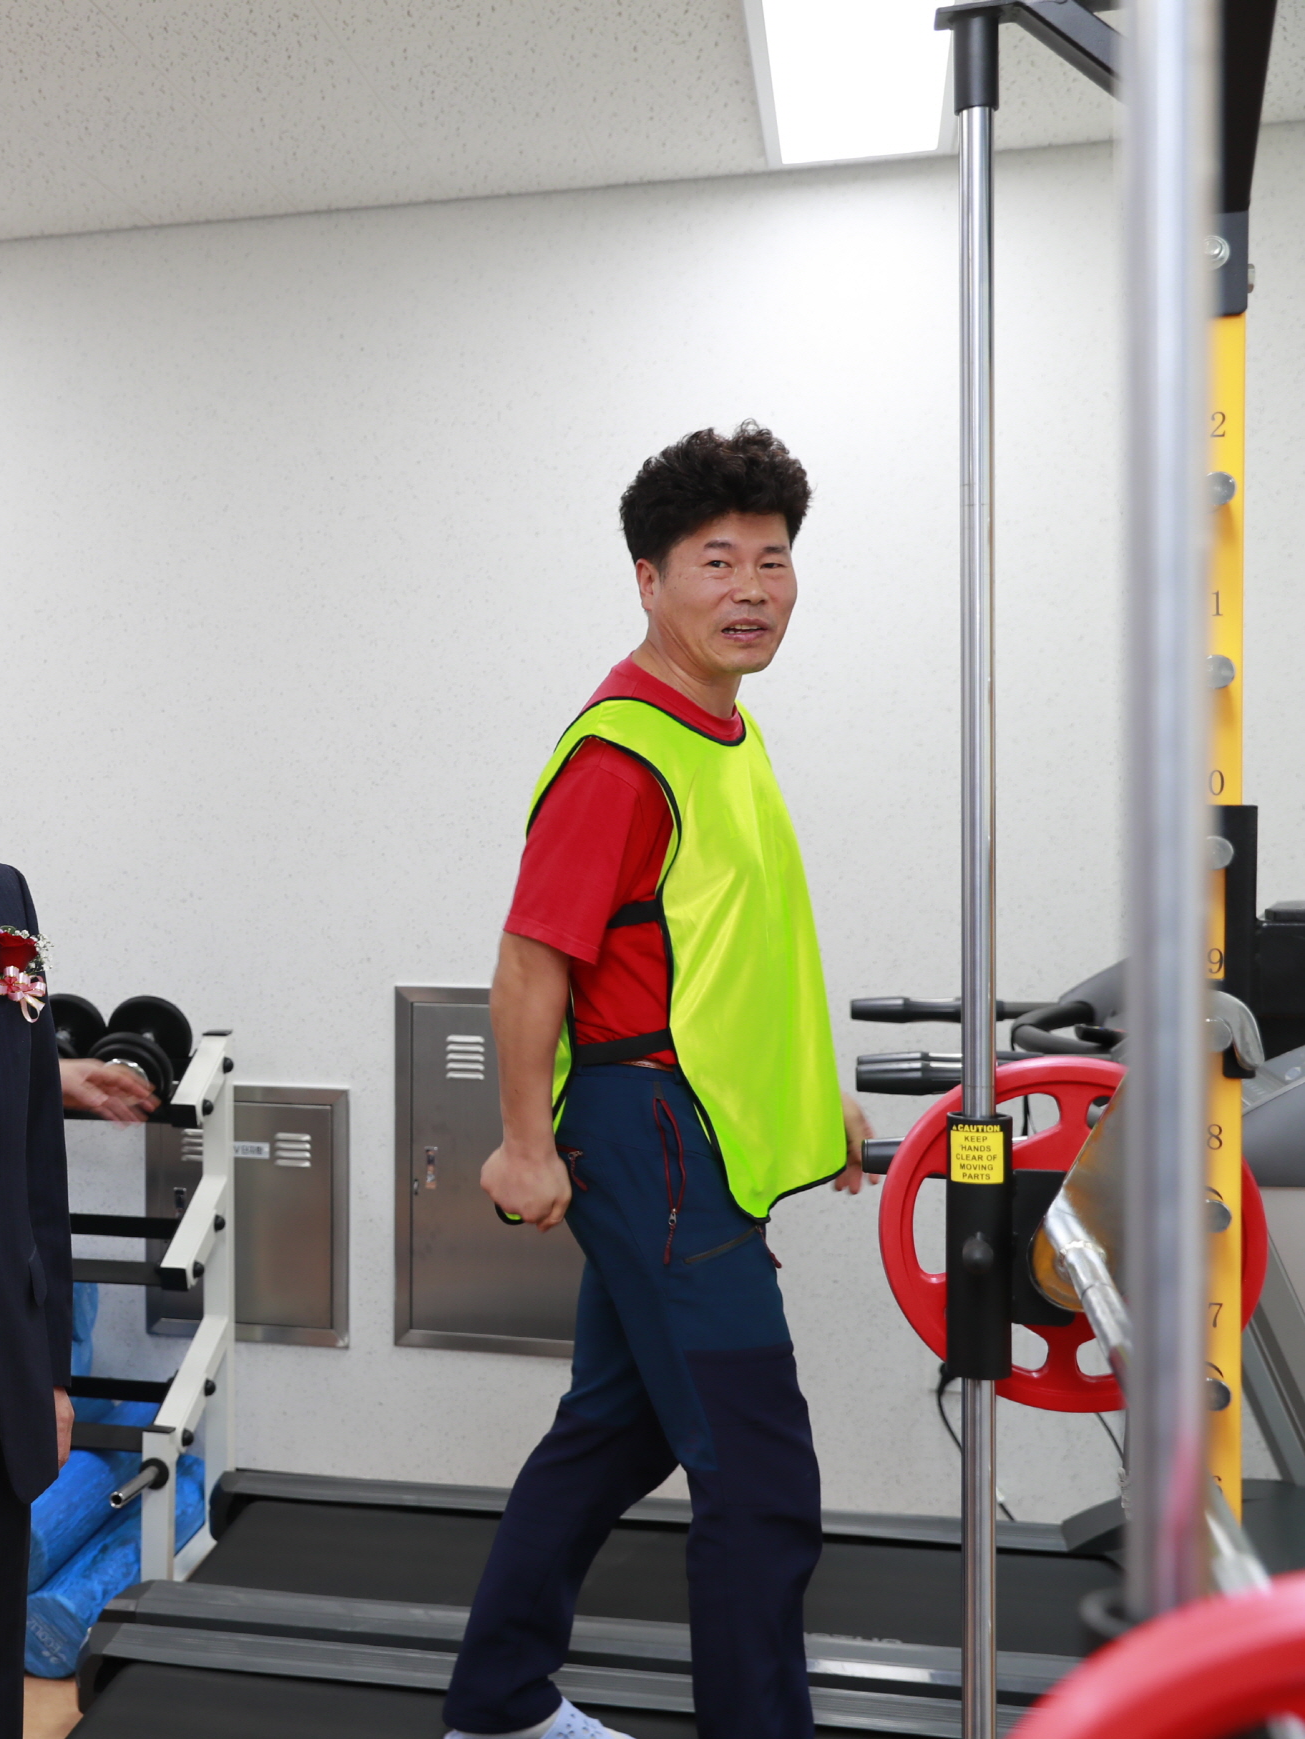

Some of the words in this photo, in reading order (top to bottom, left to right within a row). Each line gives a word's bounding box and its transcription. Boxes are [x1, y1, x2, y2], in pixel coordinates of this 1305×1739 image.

[1209, 411, 1226, 438] 2
[1211, 590, 1224, 617] 1
[1208, 769, 1225, 796] 0
[1207, 947, 1224, 975] 9
[957, 1124, 1000, 1132] CAUTION
[964, 1135, 988, 1143] KEEP
[1206, 1123, 1224, 1150] 8
[955, 1153, 984, 1161] CLEAR
[959, 1163, 994, 1171] MOVING
[962, 1172, 991, 1180] PARTS
[1207, 1302, 1224, 1329] 7
